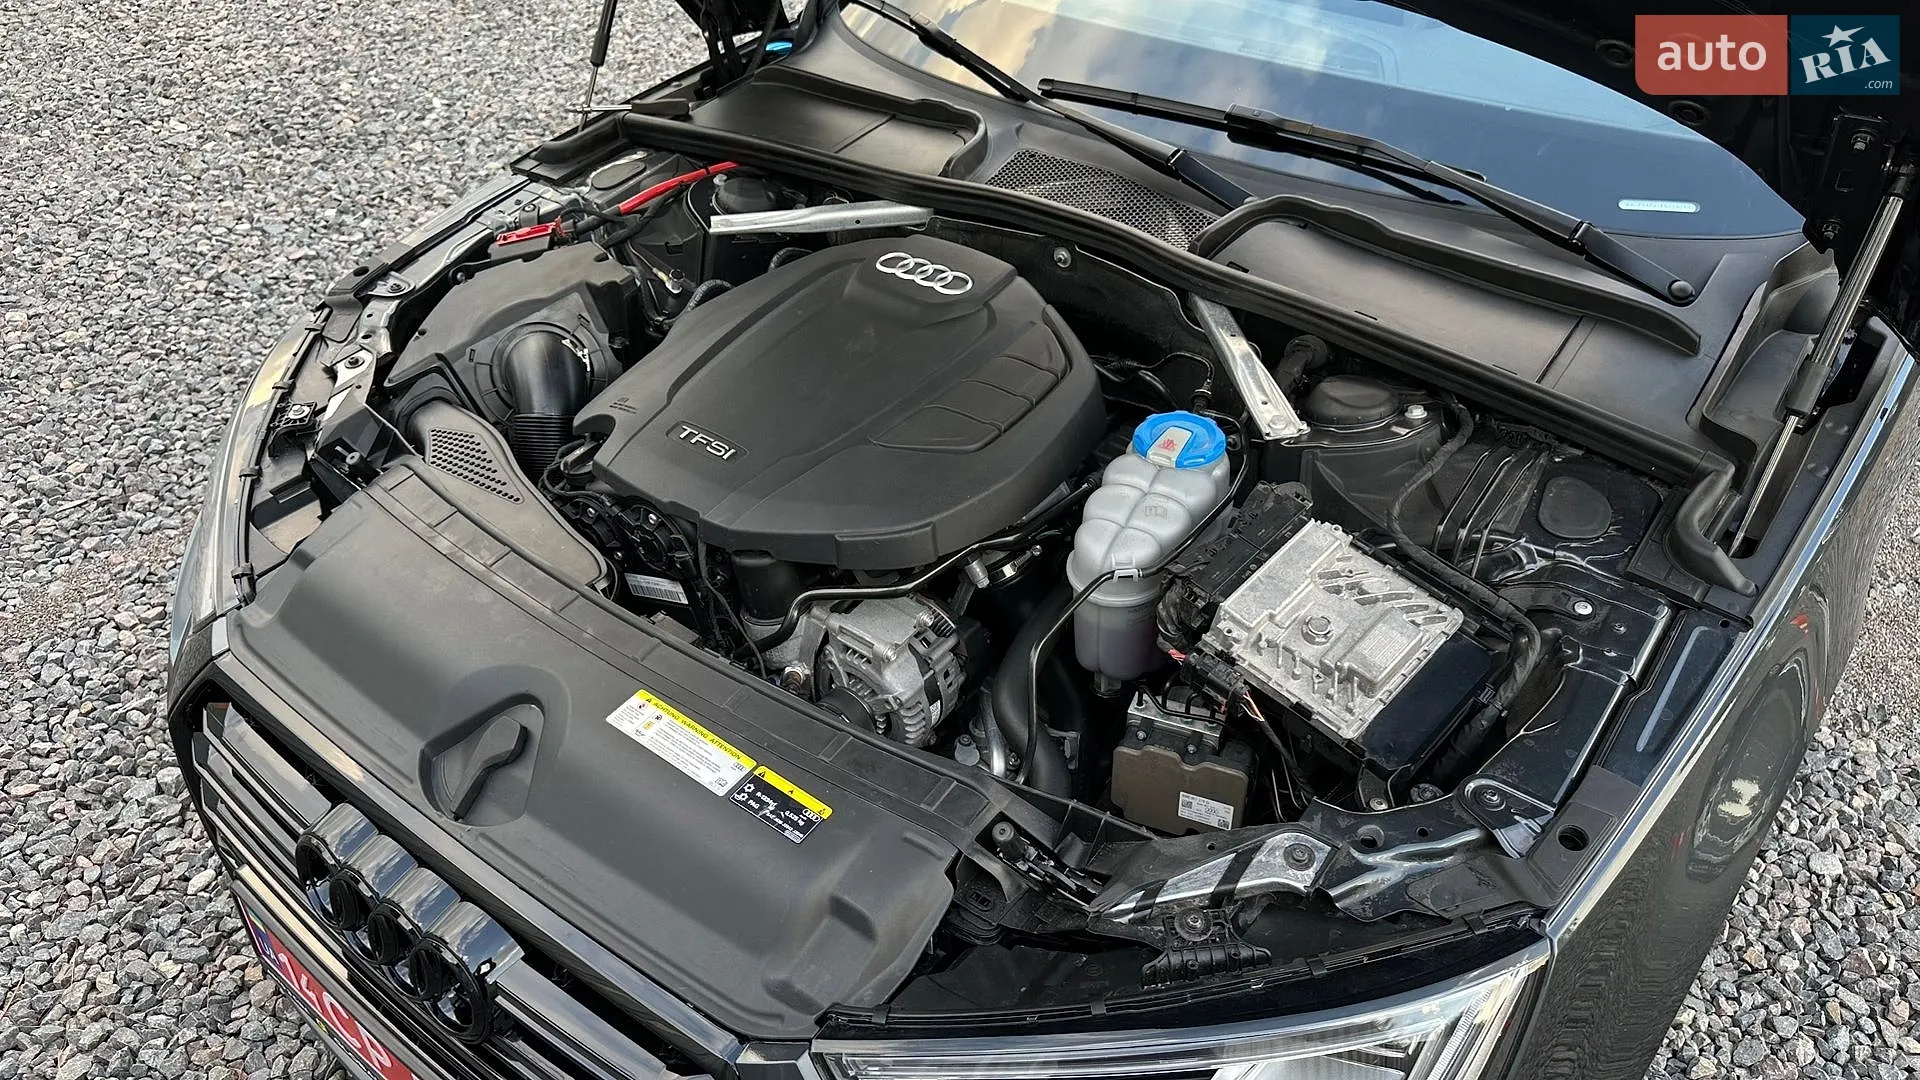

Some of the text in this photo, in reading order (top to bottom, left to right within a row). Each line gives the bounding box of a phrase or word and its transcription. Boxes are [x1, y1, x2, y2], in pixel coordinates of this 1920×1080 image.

[679, 425, 737, 460] TFSI
[653, 702, 680, 721] ACHTUNG
[681, 719, 709, 739] WARNING
[710, 738, 742, 760] ATTENTION
[748, 799, 761, 809] PAG
[258, 937, 280, 964] UA
